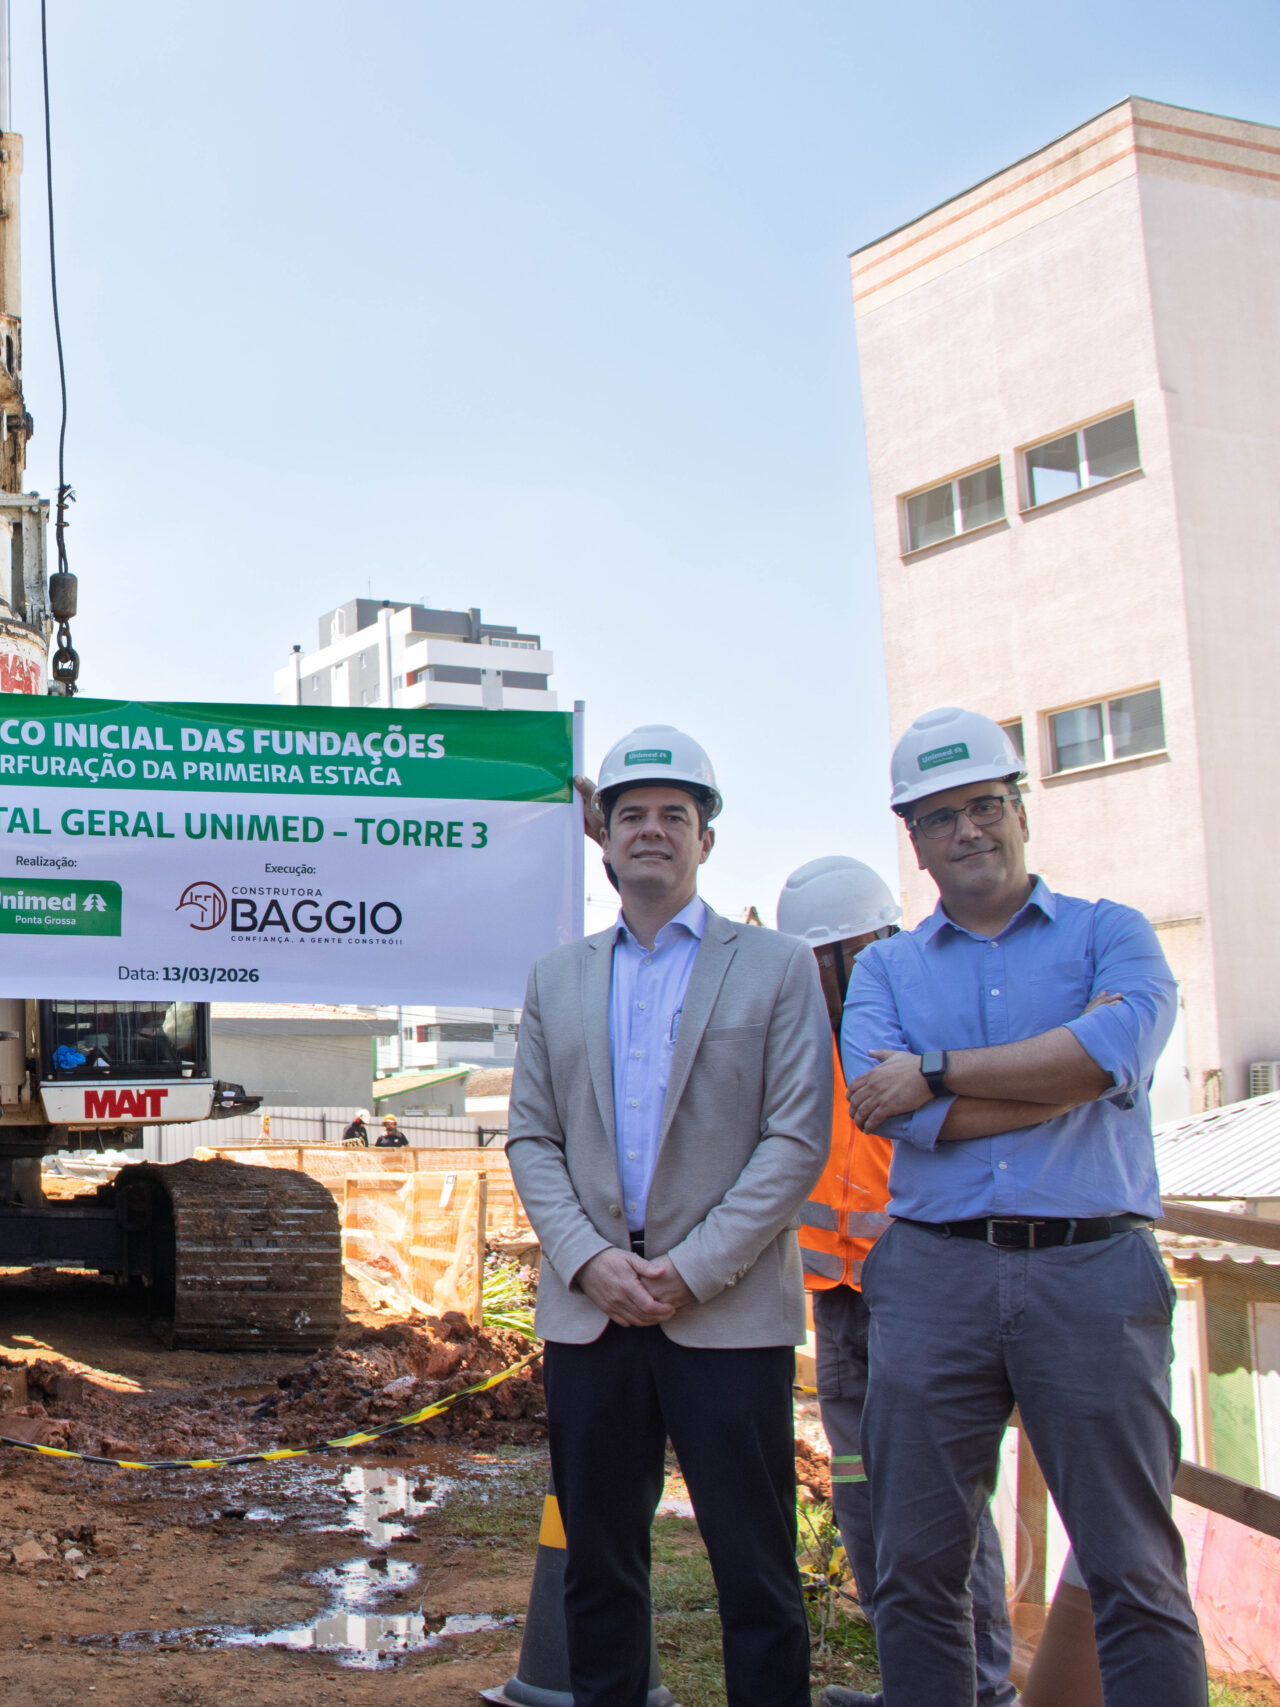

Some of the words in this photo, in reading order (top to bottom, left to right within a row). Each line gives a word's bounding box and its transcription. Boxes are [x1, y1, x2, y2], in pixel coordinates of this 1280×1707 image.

[53, 722, 174, 751] INICIAL
[180, 727, 246, 754] DAS
[253, 724, 446, 766] FUNDAÇÕES
[143, 760, 177, 780] DA
[183, 761, 305, 784] PRIMEIRA
[309, 765, 403, 786] ESTACA
[60, 808, 176, 839] GERAL
[184, 811, 325, 843] UNIMED
[354, 817, 464, 849] TORRE
[470, 820, 489, 849] 3
[15, 855, 78, 870] Realização:
[264, 863, 317, 877] Execução:
[231, 886, 323, 897] CONSTRUTORA
[15, 915, 42, 925] Ponta
[44, 915, 77, 926] Grossa
[230, 898, 403, 935] BAGGIO
[310, 937, 343, 945] GENTE
[117, 965, 160, 982] Data:
[161, 966, 261, 985] 13/03/2026
[84, 1088, 169, 1119] MAIT
